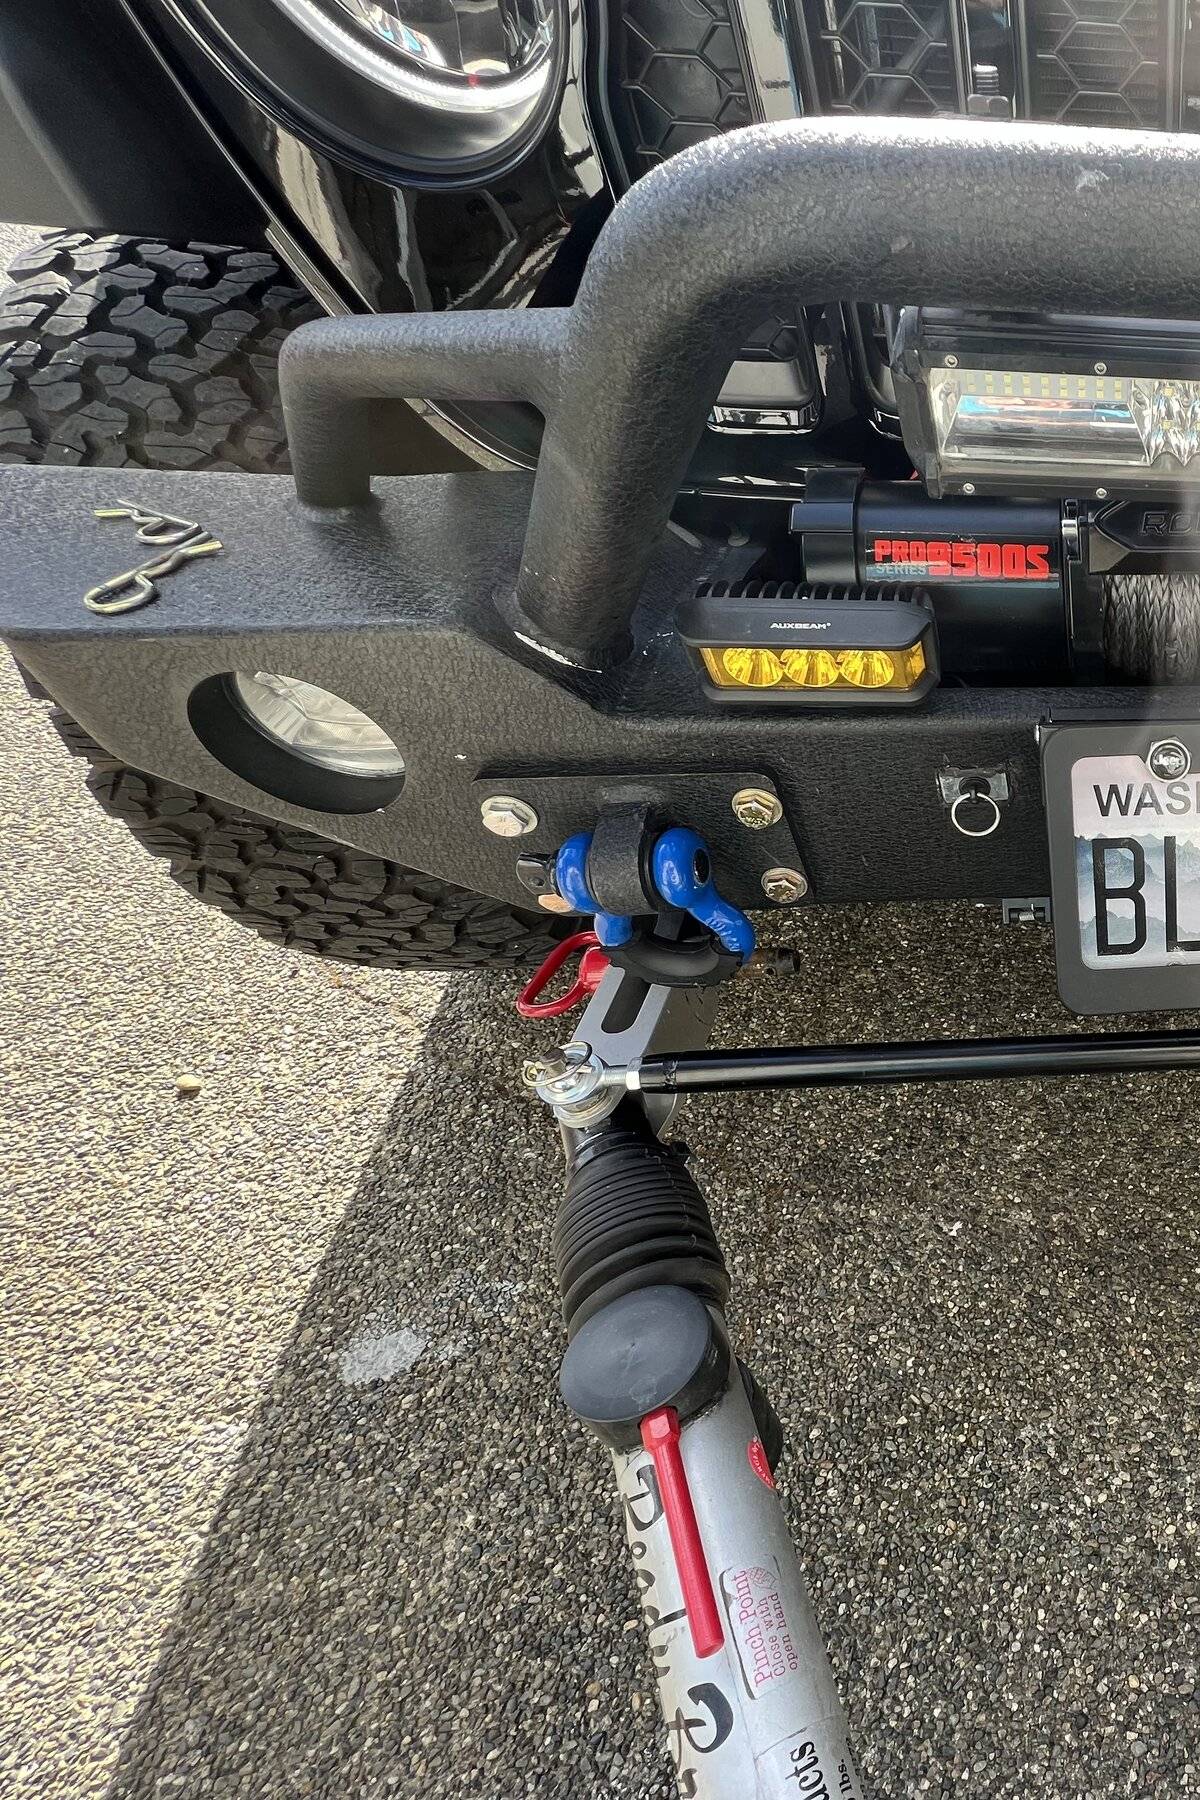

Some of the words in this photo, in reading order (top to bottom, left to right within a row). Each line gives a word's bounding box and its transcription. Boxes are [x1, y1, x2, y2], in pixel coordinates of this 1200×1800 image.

[876, 564, 927, 576] SERIES
[733, 1569, 757, 1625] Point
[756, 1597, 774, 1631] with
[768, 1592, 788, 1631] hand
[745, 1626, 774, 1688] Pinch
[768, 1634, 786, 1677] Close
[782, 1633, 799, 1671] open
